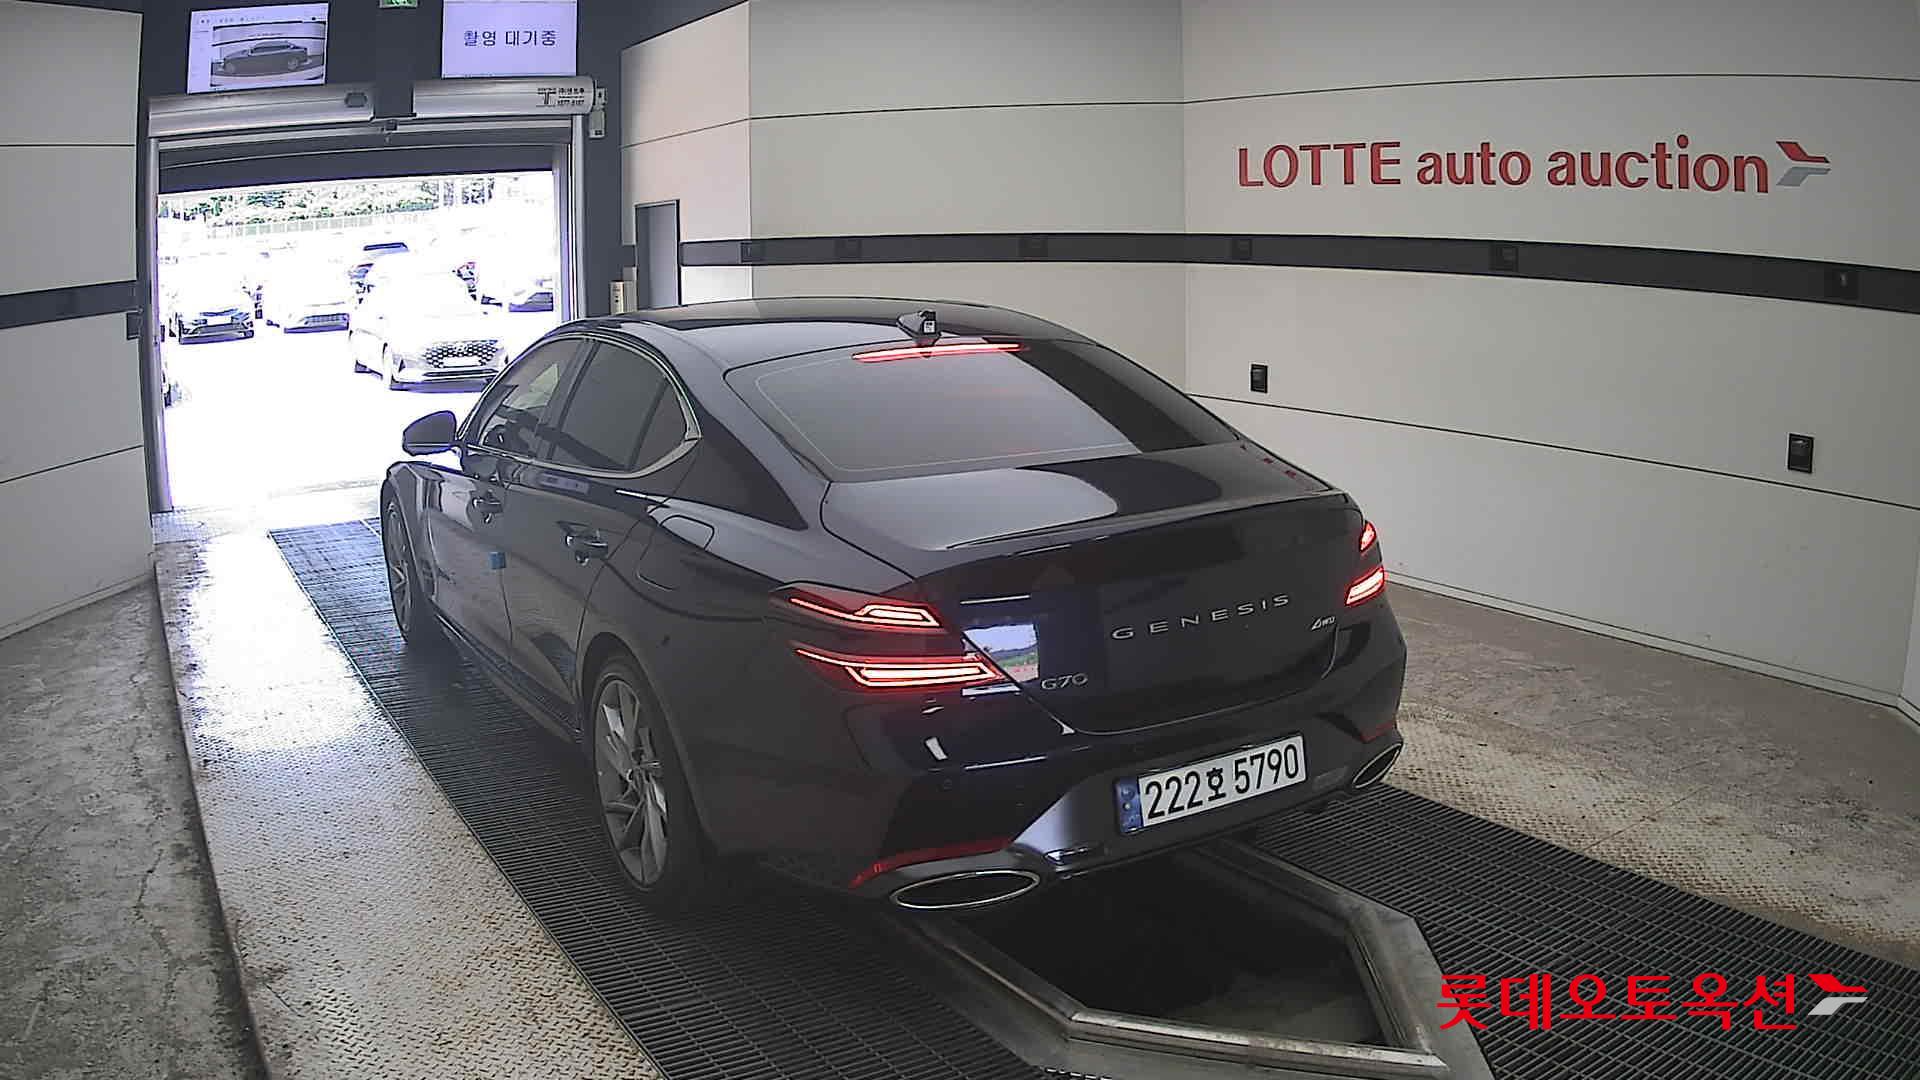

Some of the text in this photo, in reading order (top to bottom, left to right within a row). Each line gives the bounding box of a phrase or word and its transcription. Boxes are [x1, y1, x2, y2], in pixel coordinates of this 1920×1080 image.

[464, 30, 557, 47] 촬영 대기중
[1239, 135, 1769, 193] LOTTE auto auction
[1111, 594, 1291, 640] GENESIS
[1041, 672, 1088, 690] G70
[1144, 743, 1299, 820] 222호 5790
